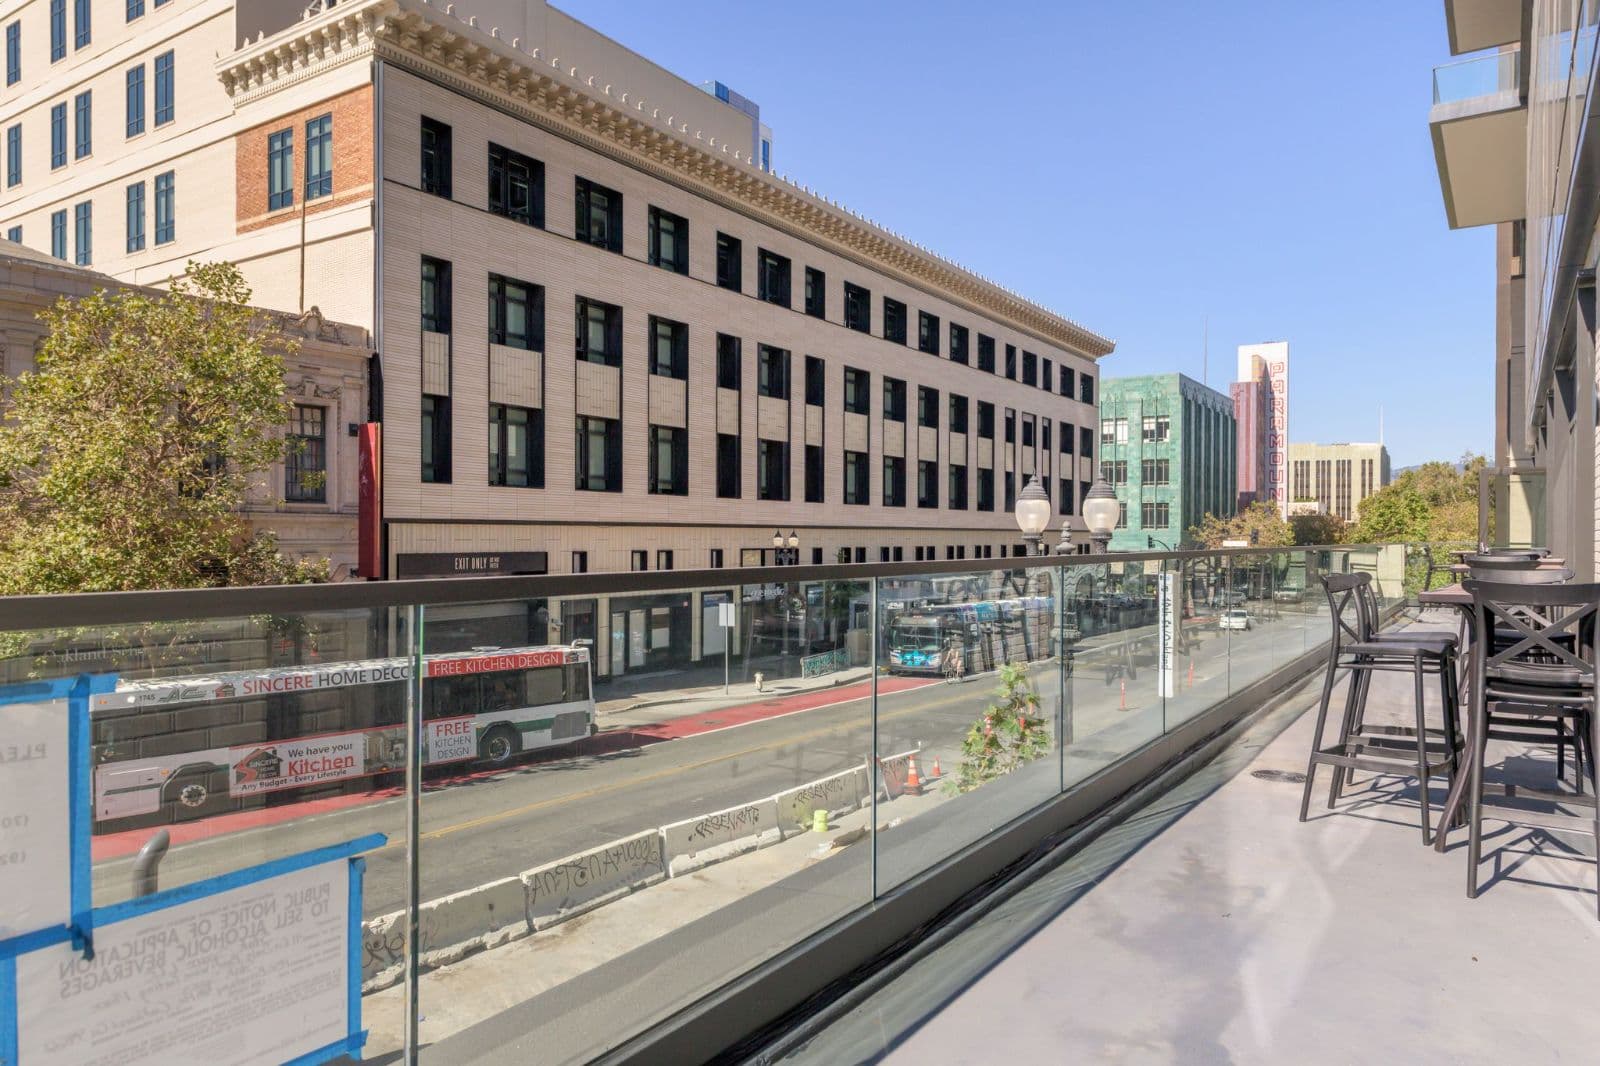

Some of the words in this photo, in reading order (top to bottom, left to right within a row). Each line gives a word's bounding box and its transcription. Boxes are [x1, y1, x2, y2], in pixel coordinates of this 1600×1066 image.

[454, 557, 469, 570] EXIT
[471, 557, 487, 570] ONLY
[434, 662, 461, 675] FREE
[465, 656, 515, 673] KITCHEN
[518, 653, 559, 668] DESIGN
[243, 674, 314, 694] SINCERE
[318, 669, 367, 688] HOME
[371, 665, 409, 682] DECO
[436, 721, 471, 737] FREE
[434, 735, 472, 748] KITCHEN
[287, 748, 304, 758] We
[306, 745, 330, 756] have
[437, 747, 470, 760] DESIGN
[288, 755, 355, 776] Kitchen
[241, 783, 257, 792] Any
[259, 778, 288, 789] Budget
[294, 774, 315, 784] Every
[317, 769, 347, 779] Lifestyle
